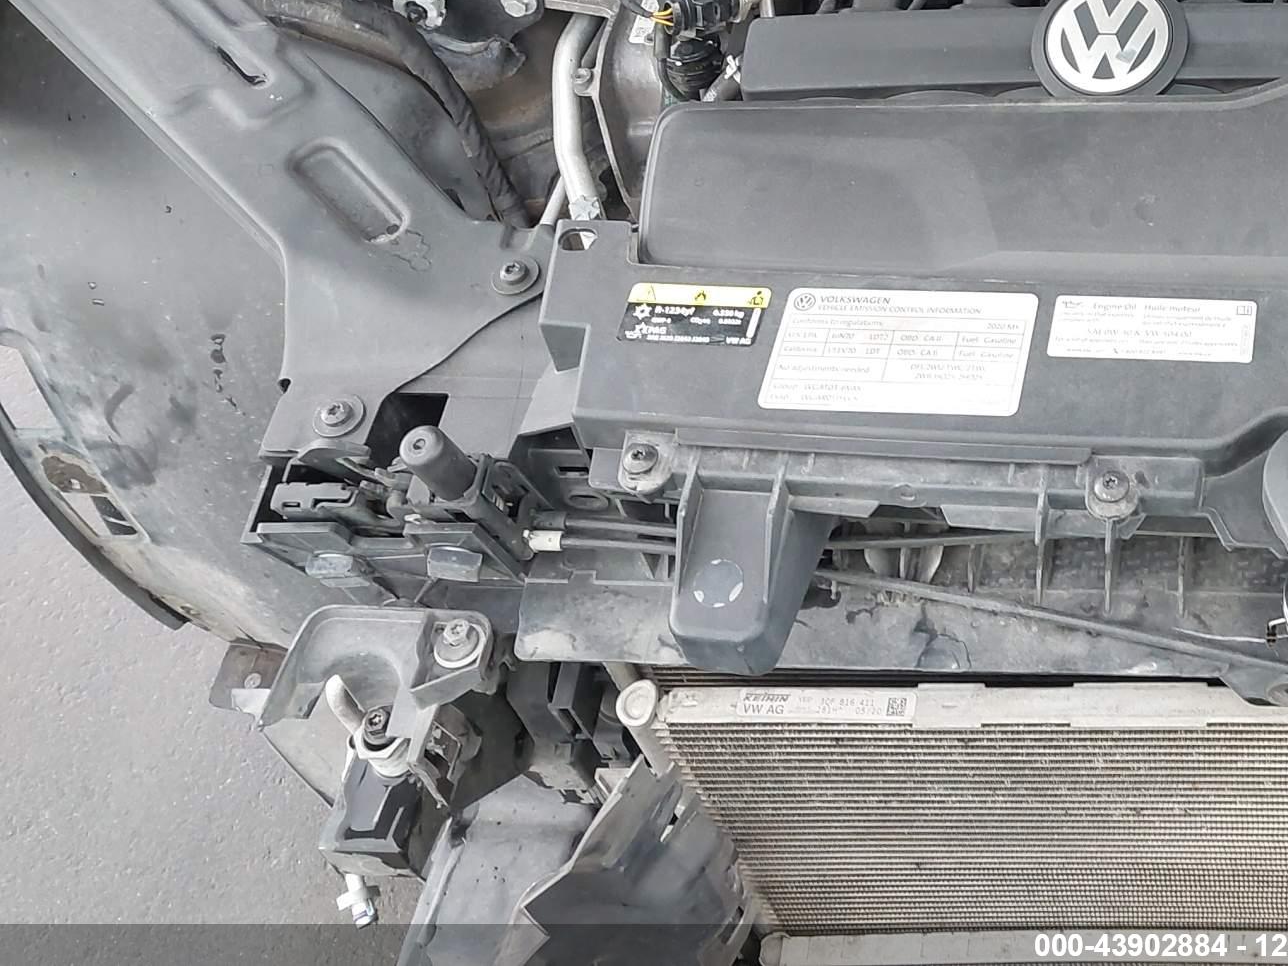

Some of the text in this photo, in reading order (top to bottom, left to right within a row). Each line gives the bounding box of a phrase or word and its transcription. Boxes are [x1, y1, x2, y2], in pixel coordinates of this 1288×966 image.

[821, 295, 891, 305] VOLKSWAGEN
[743, 703, 764, 714] VW
[766, 704, 785, 715] AG
